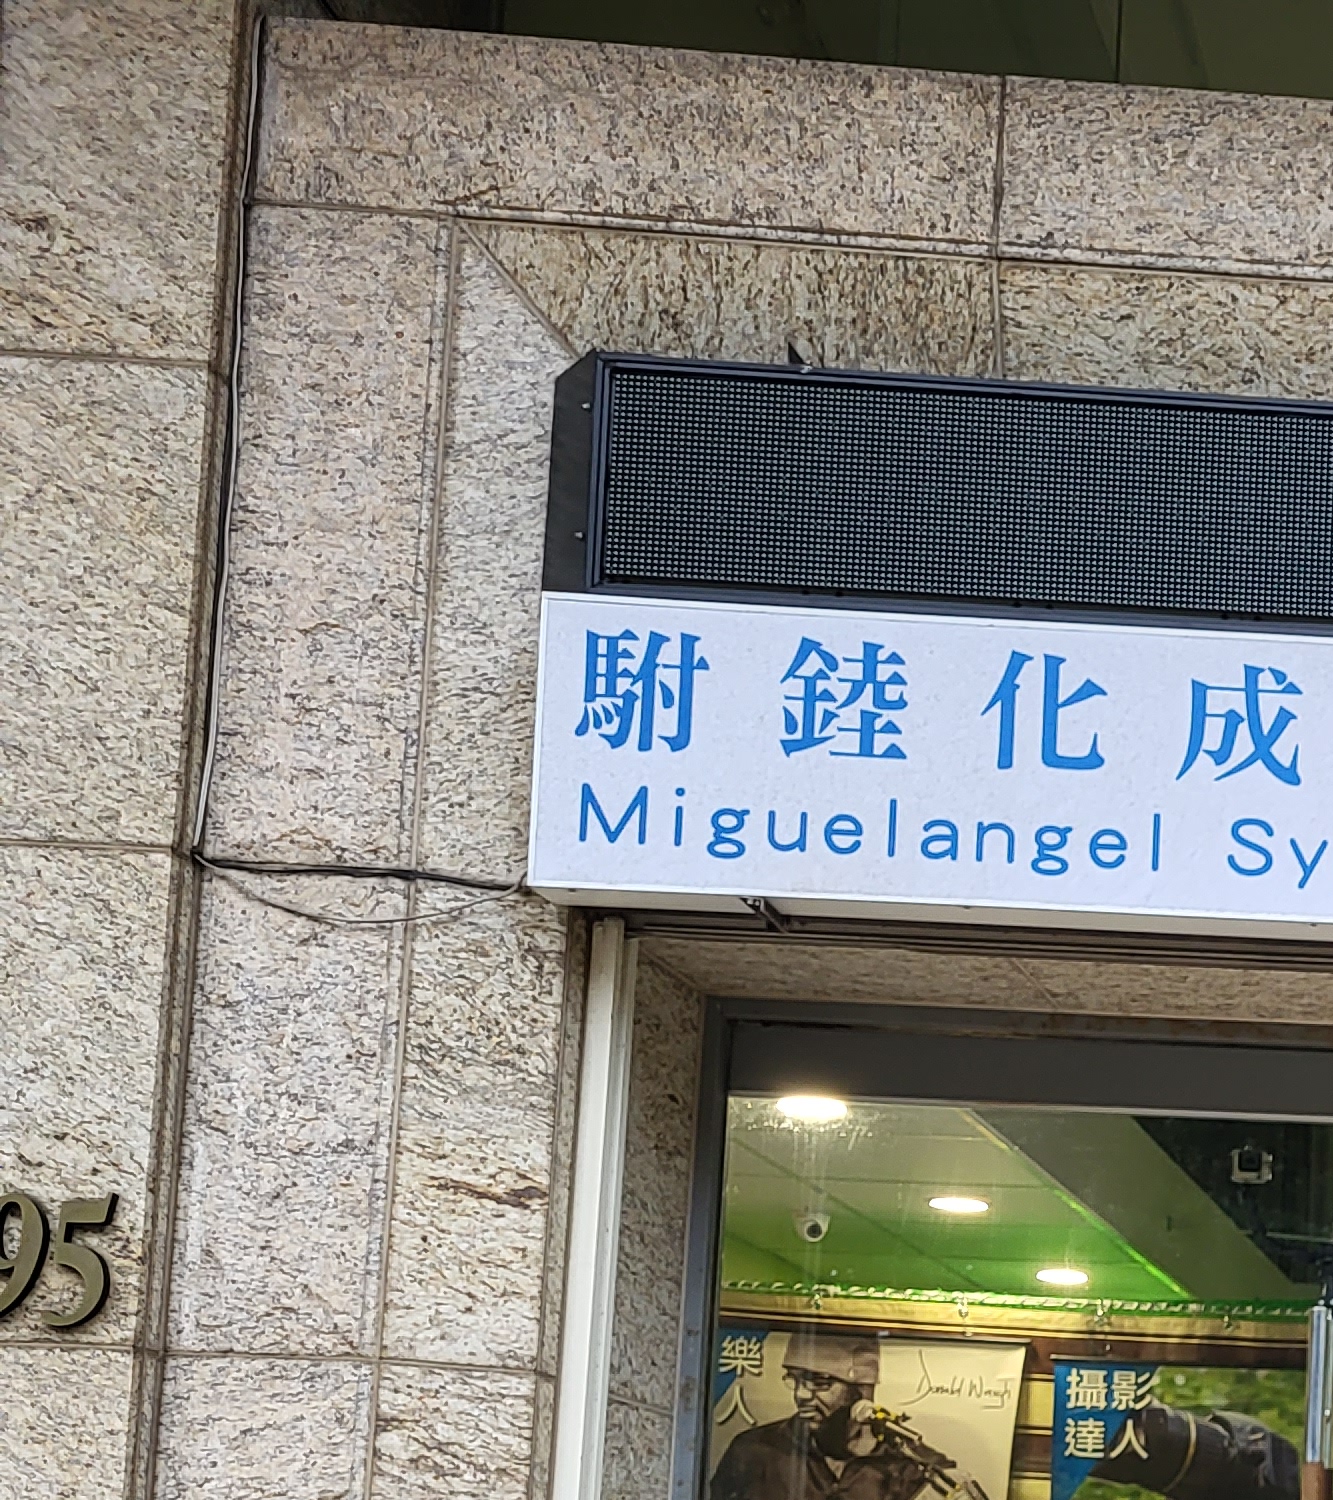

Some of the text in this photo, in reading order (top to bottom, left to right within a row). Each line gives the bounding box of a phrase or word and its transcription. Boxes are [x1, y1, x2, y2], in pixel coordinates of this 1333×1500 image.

[578, 782, 1161, 877] Miguelangel
[1066, 1368, 1157, 1411] 攝影
[1064, 1417, 1149, 1460] 達人
